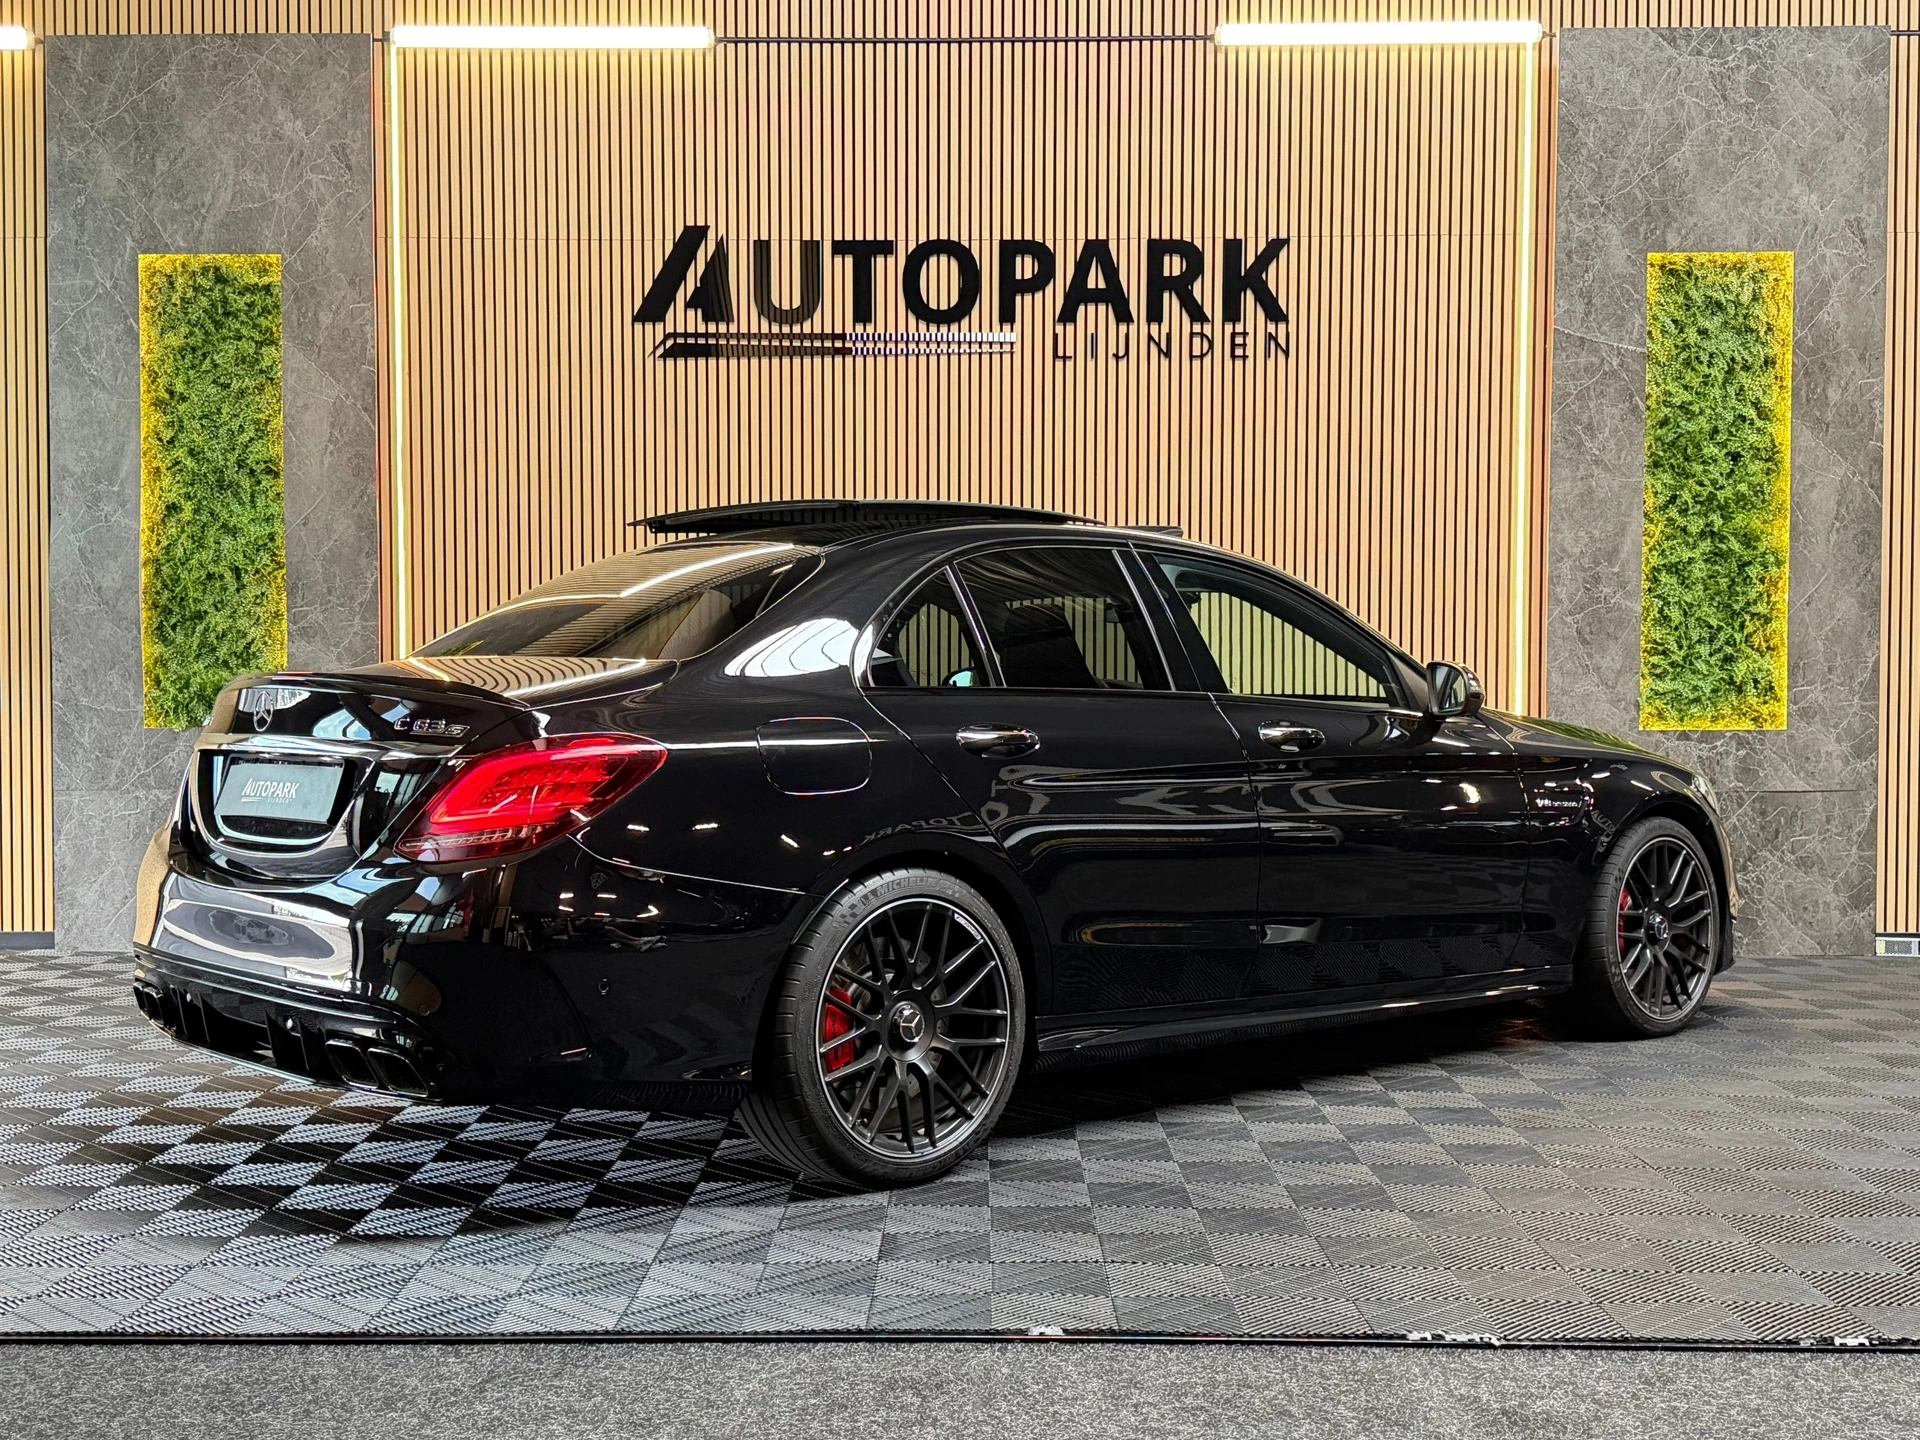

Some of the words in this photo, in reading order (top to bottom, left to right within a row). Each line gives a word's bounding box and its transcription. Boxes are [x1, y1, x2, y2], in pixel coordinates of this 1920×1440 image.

[632, 225, 1290, 325] AUTOPARK
[1055, 331, 1290, 361] LIJNDEN
[241, 778, 300, 799] AUTOPARK
[876, 876, 939, 897] MICHELIN
